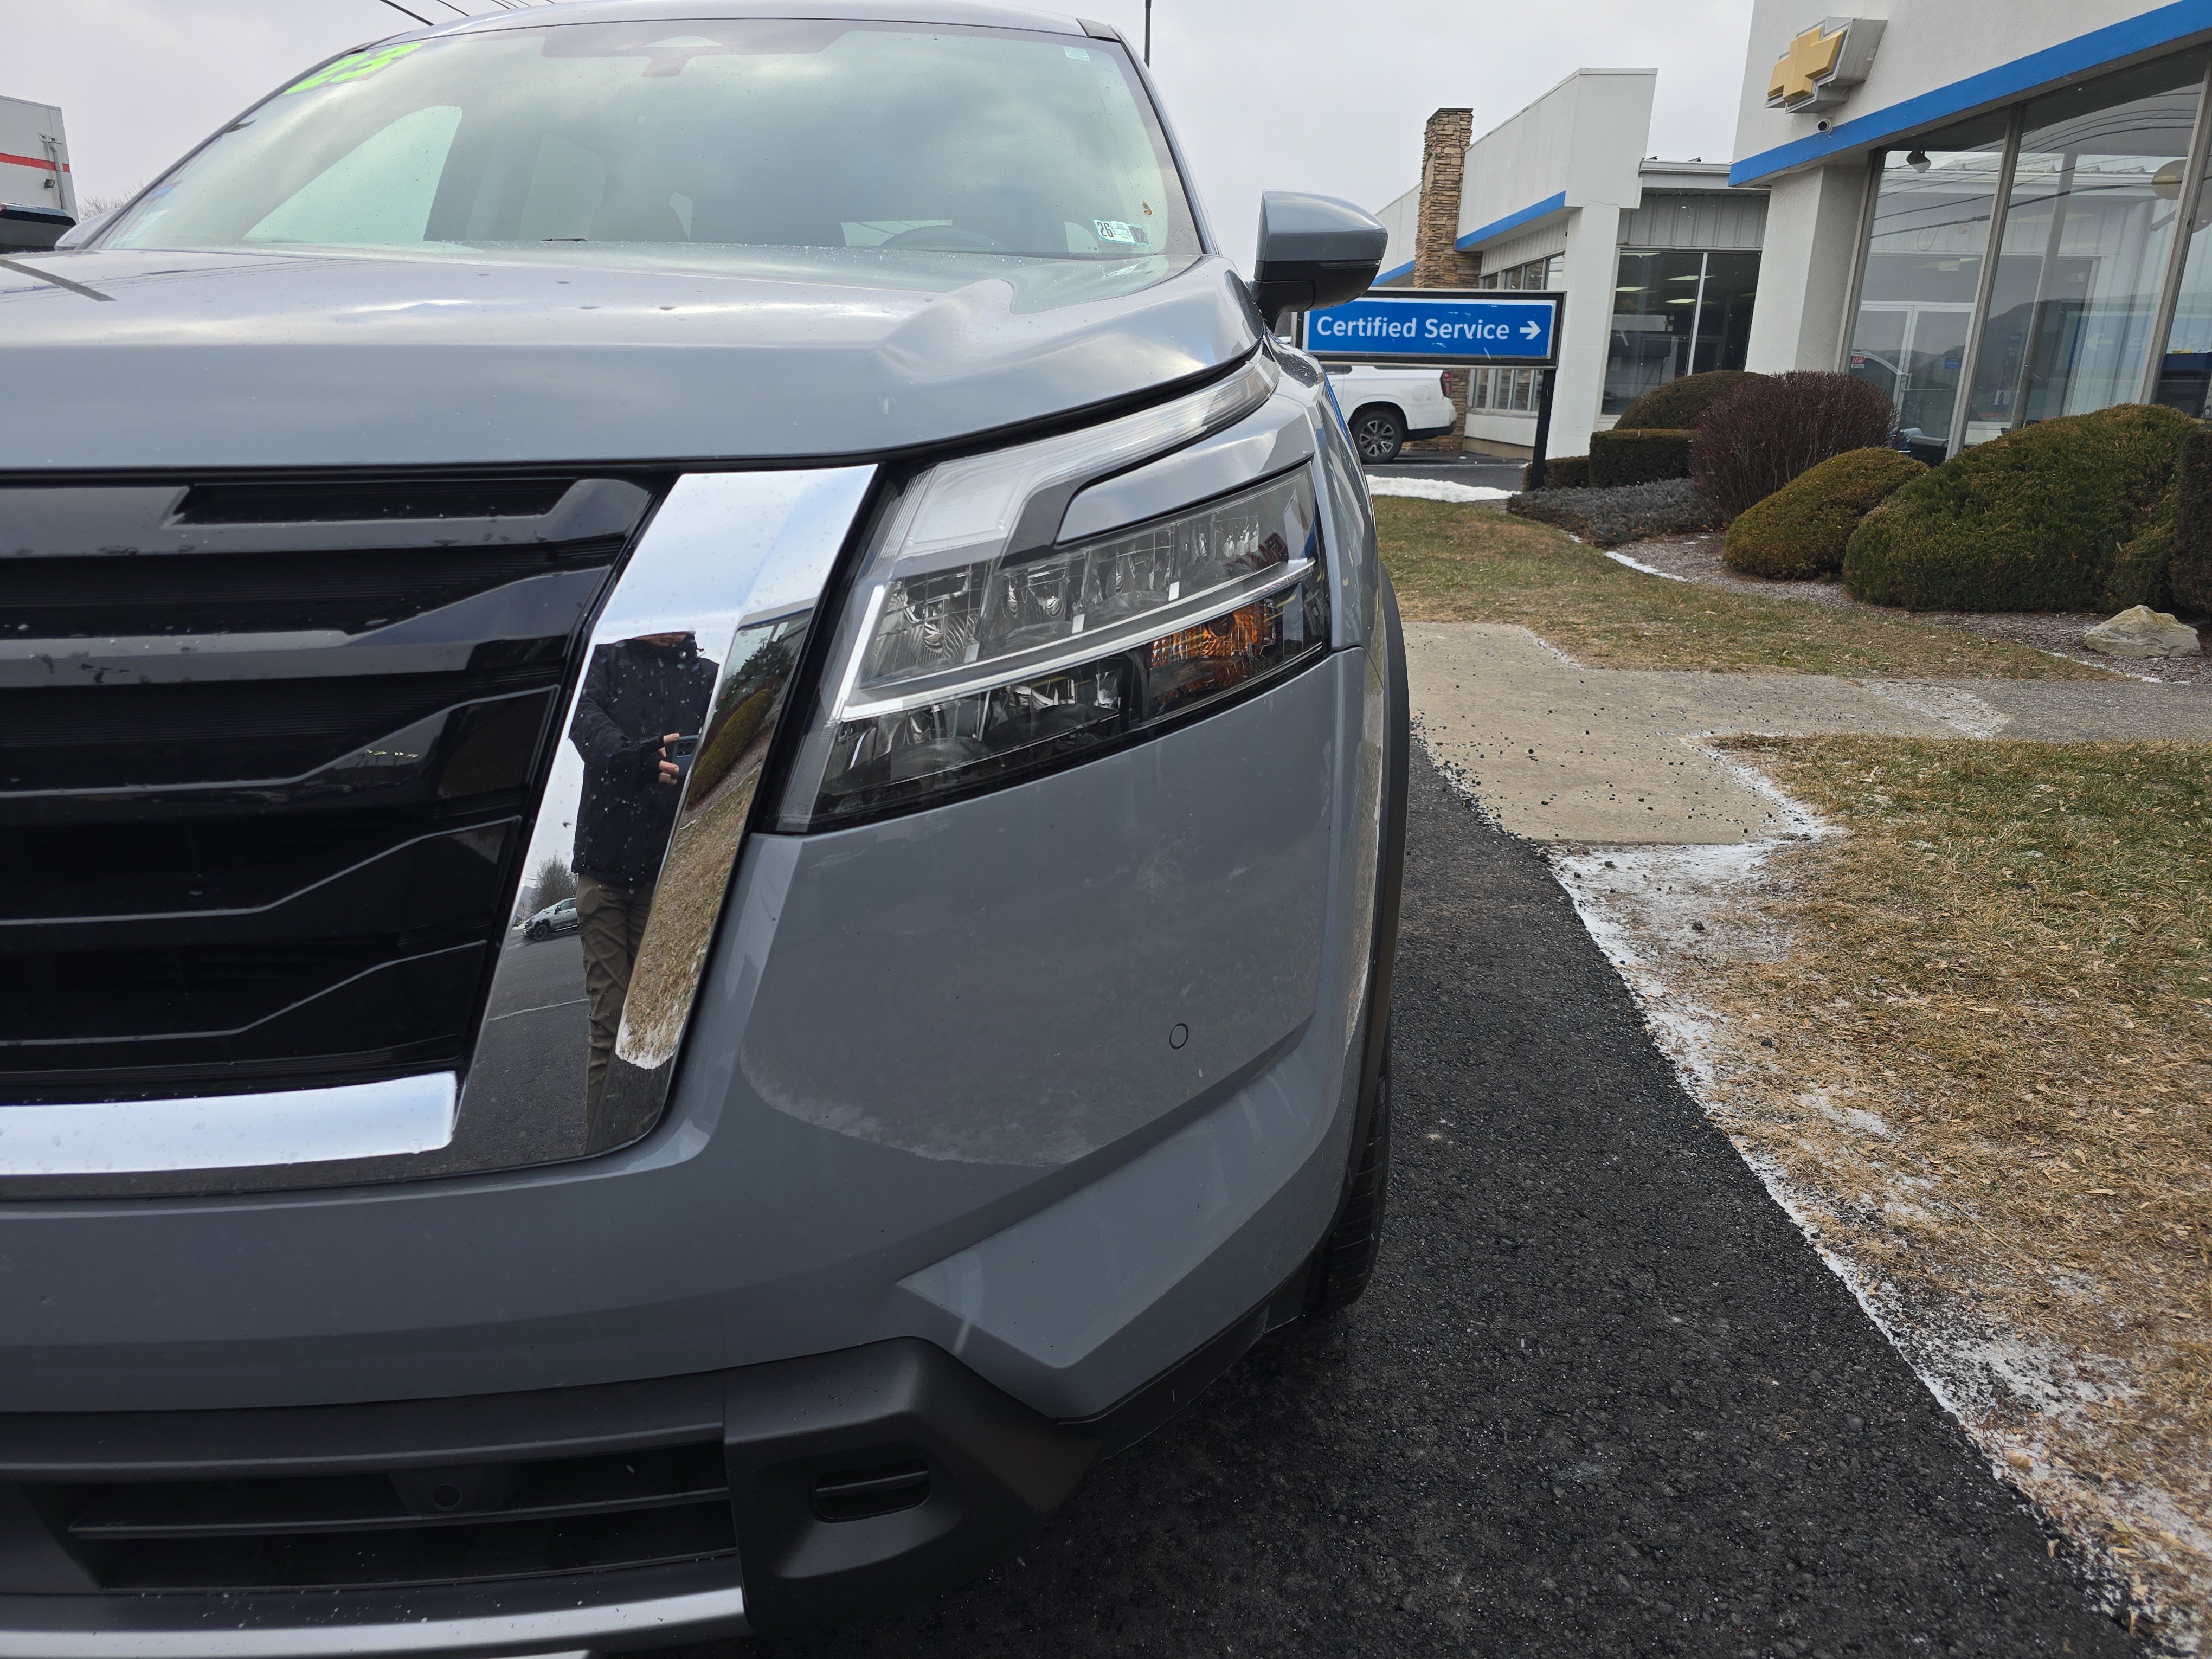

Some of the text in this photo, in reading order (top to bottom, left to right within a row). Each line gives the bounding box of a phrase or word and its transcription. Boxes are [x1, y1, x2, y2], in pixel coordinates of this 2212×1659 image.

[283, 42, 423, 96] 23
[1096, 221, 1114, 237] 26
[1317, 316, 1510, 340] Certified Service
